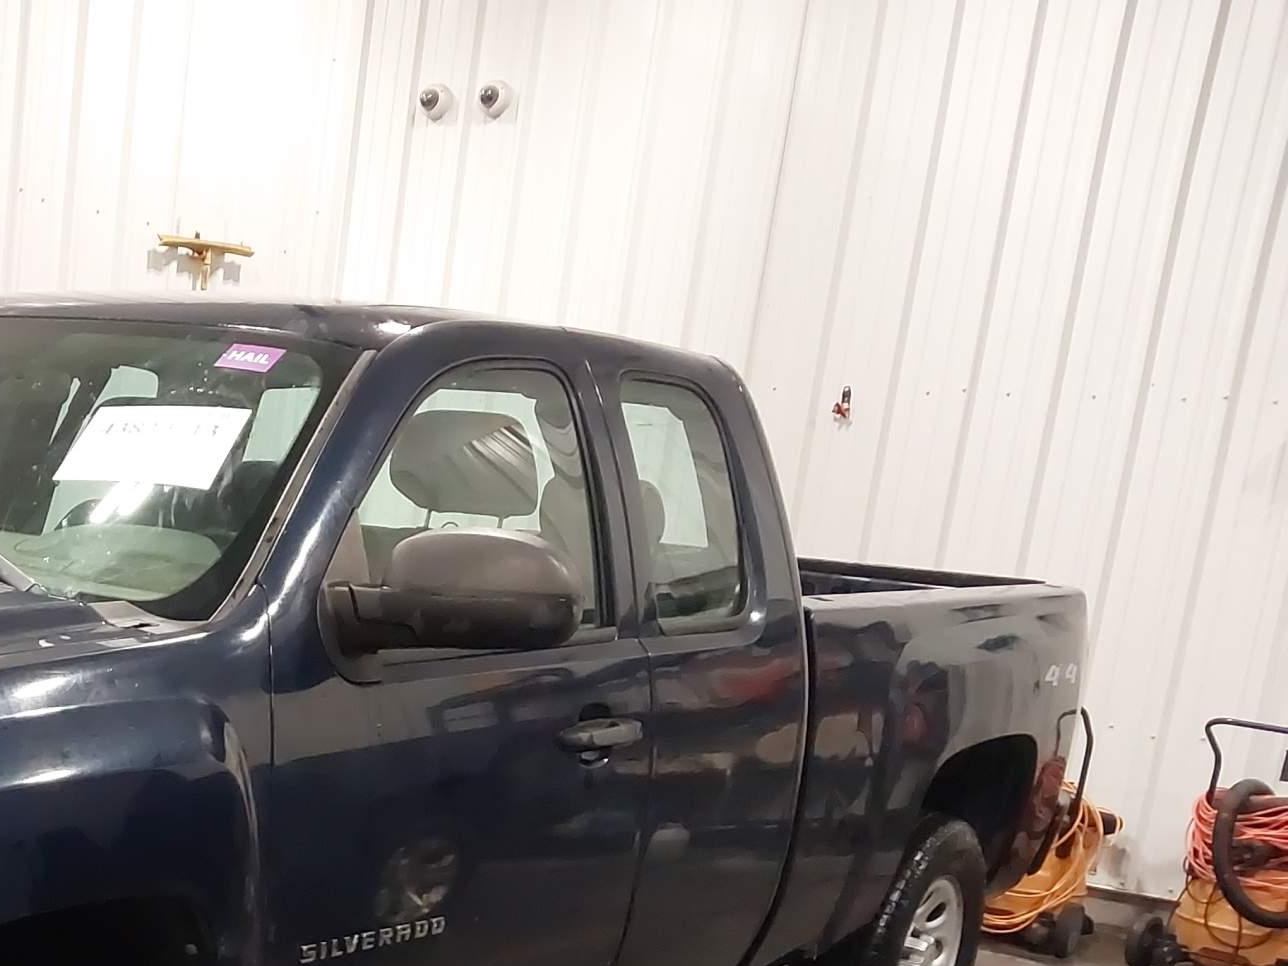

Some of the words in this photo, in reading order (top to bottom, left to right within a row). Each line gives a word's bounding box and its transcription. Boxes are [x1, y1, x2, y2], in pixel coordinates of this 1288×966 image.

[227, 350, 270, 365] HAIL
[1044, 663, 1078, 687] 44
[299, 916, 446, 964] SILVERADO
